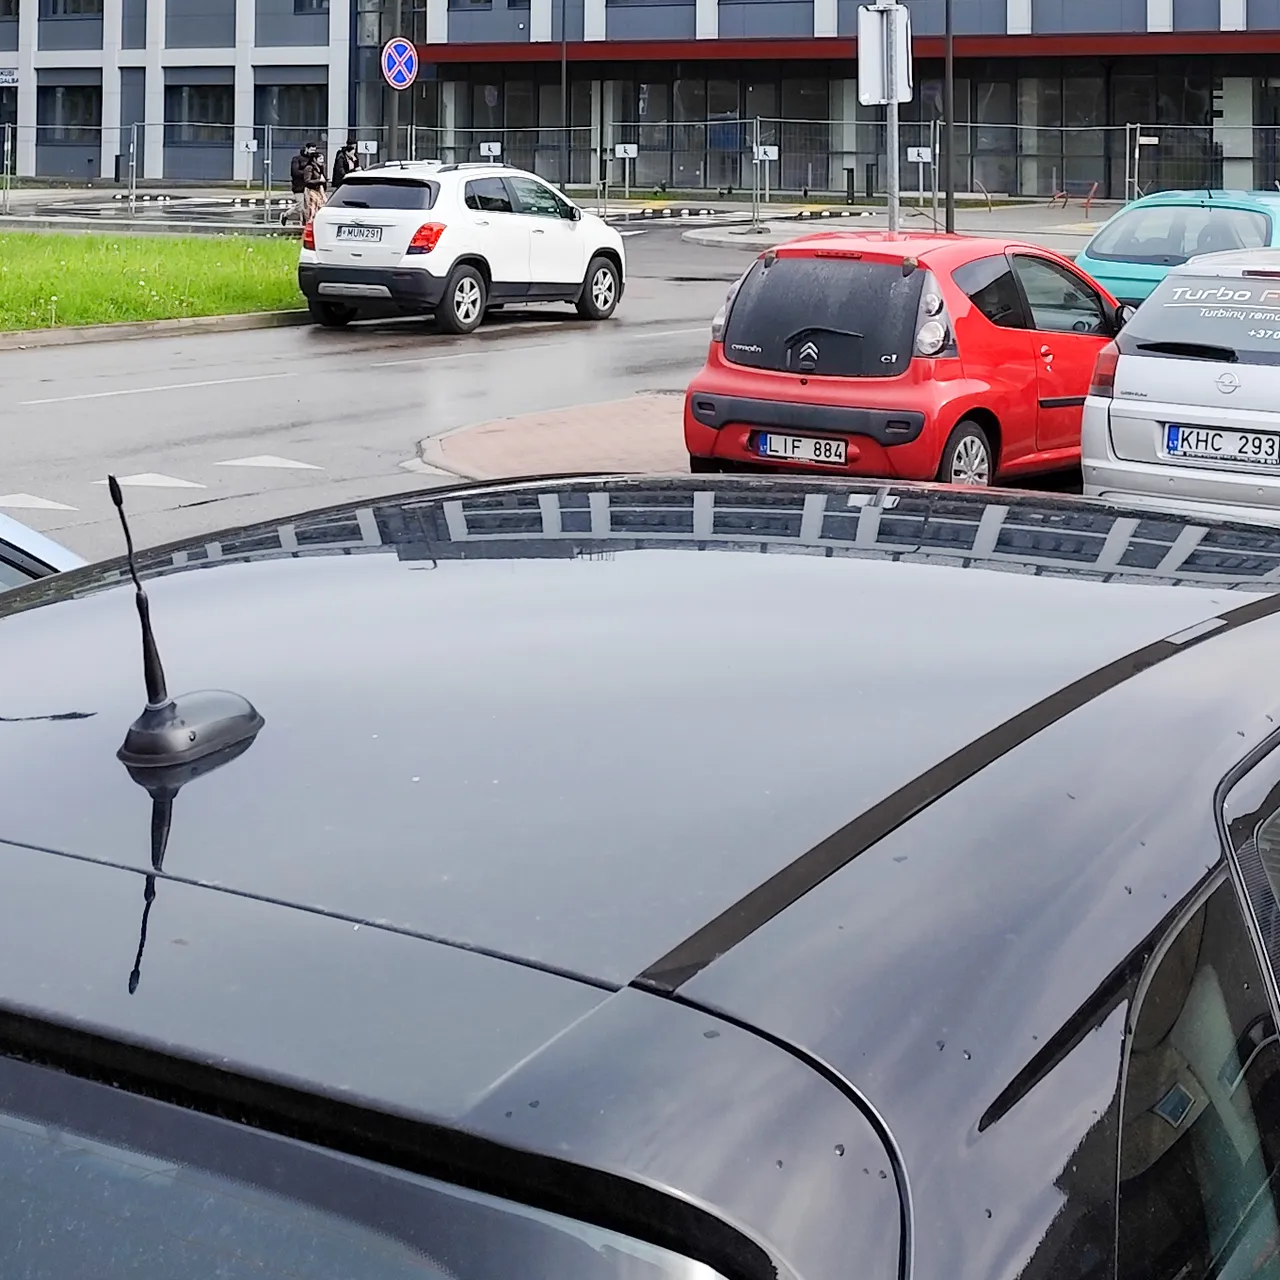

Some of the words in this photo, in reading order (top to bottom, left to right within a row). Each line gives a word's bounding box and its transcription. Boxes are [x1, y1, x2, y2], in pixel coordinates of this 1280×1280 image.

[347, 228, 379, 238] MUN291
[1173, 286, 1252, 301] Turbo
[769, 436, 802, 455] LIF
[813, 440, 842, 460] 884
[1180, 429, 1224, 452] KHC
[1238, 435, 1276, 457] 293
